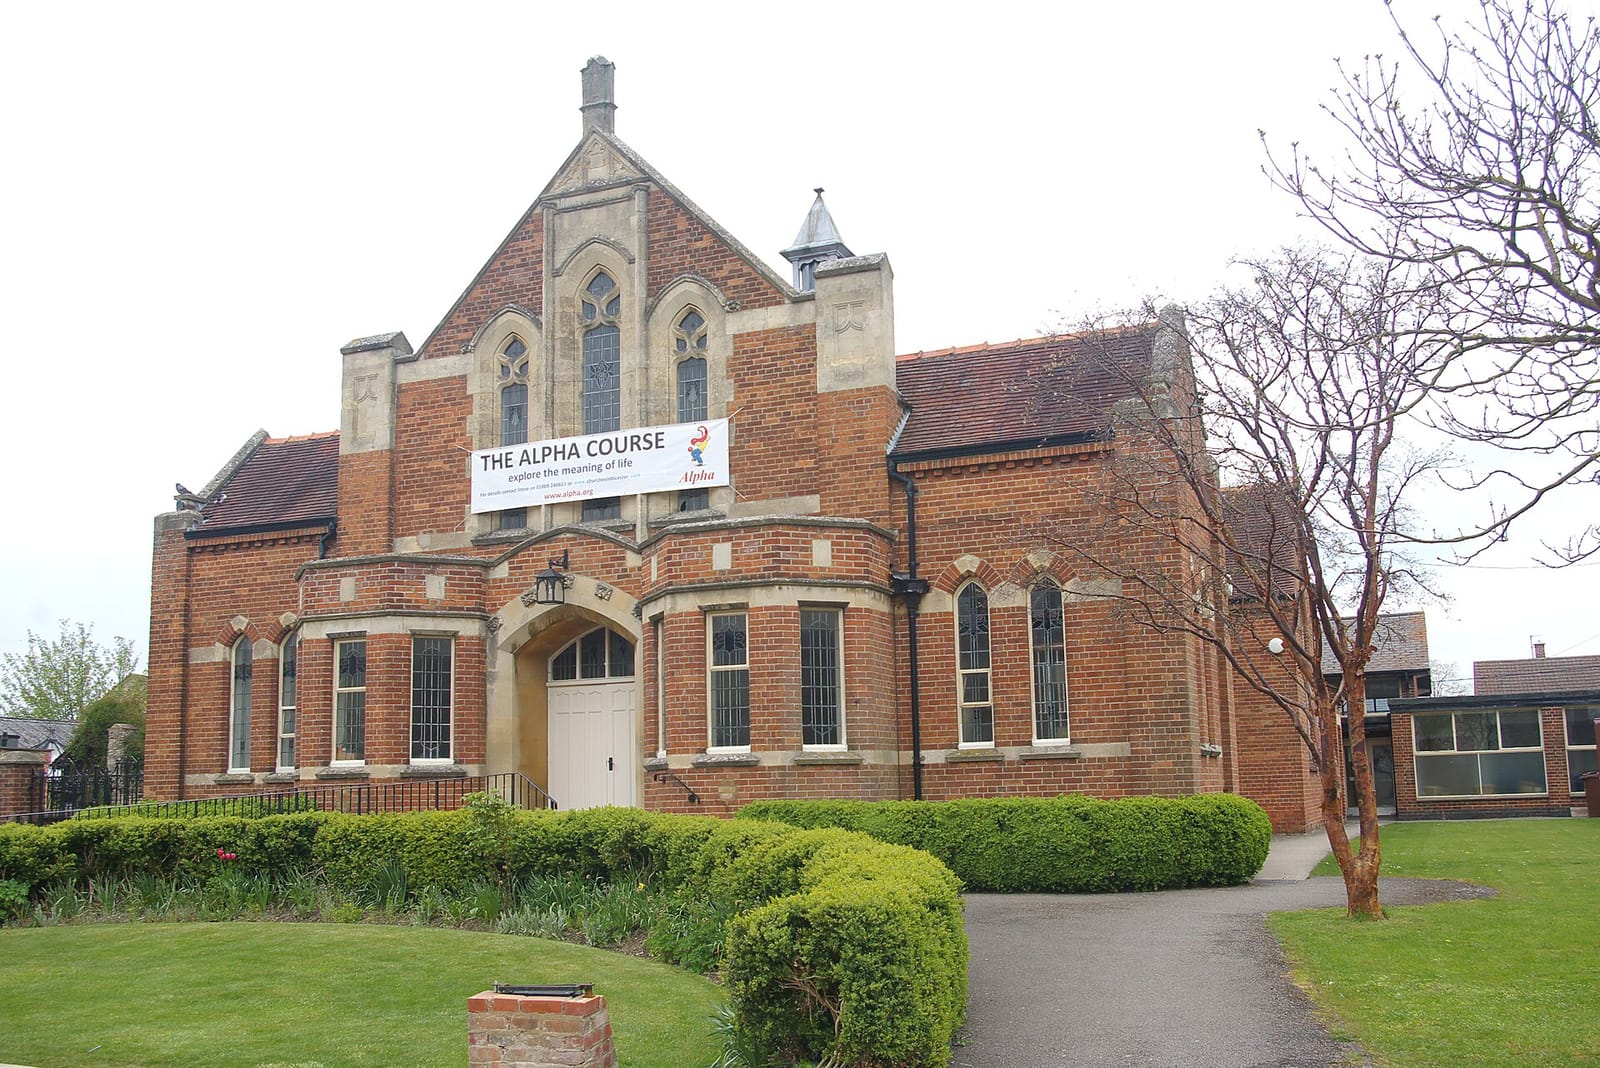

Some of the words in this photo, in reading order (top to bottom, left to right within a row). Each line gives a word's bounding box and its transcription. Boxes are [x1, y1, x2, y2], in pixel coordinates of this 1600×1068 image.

[480, 451, 514, 472] THE
[519, 442, 581, 467] ALPHA
[586, 431, 665, 457] COURSE
[508, 471, 541, 483] explore
[543, 467, 559, 477] the
[561, 462, 603, 475] meaning
[605, 459, 616, 470] of
[617, 457, 633, 469] life
[681, 469, 715, 485] Alpha
[543, 489, 595, 500] www.alpha.org
